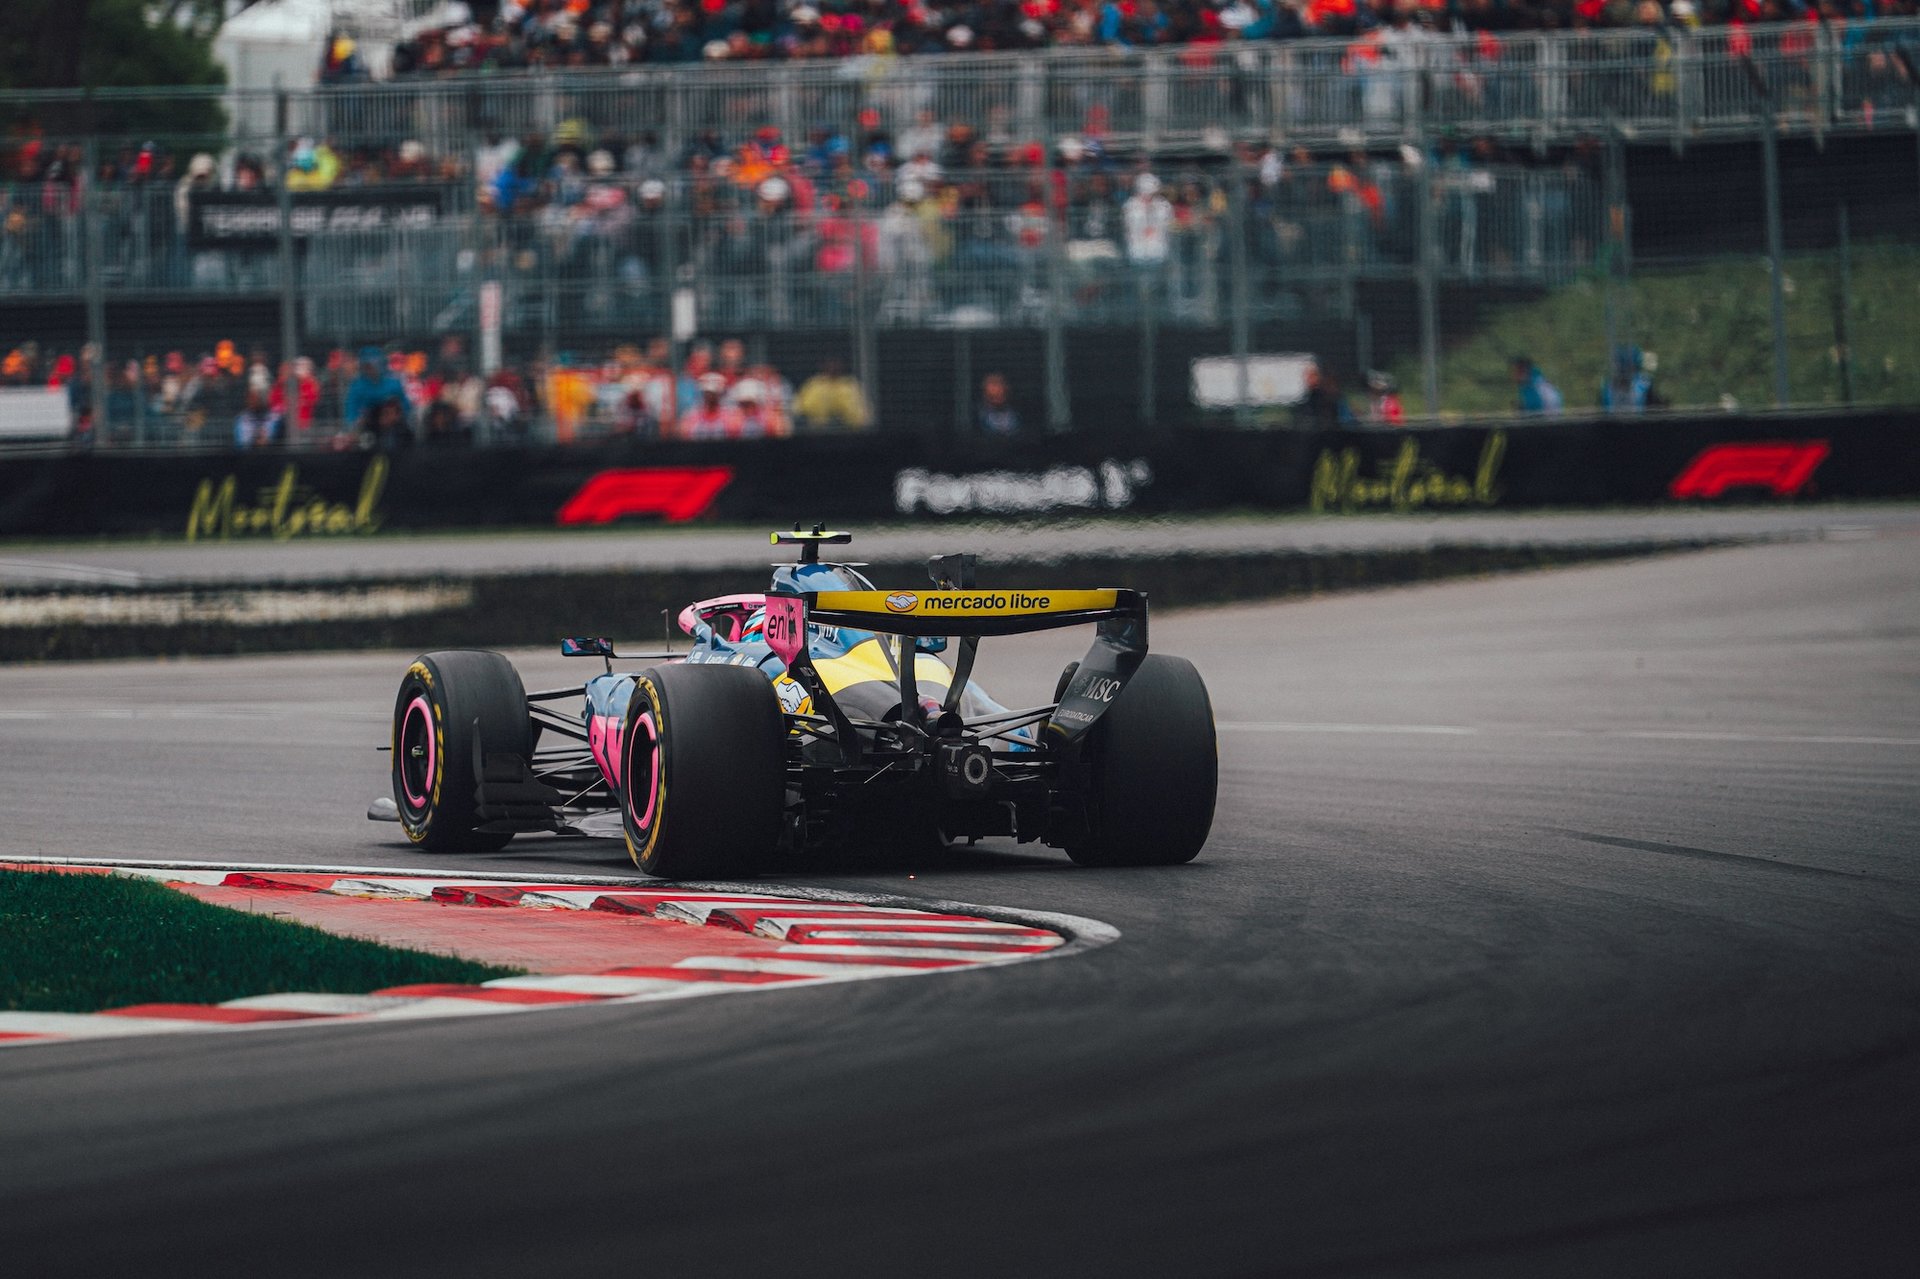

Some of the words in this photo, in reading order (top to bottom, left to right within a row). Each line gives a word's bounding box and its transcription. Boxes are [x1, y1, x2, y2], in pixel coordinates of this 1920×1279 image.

[924, 594, 1006, 609] mercado
[1010, 594, 1050, 609] libre
[1081, 676, 1121, 702] MSC
